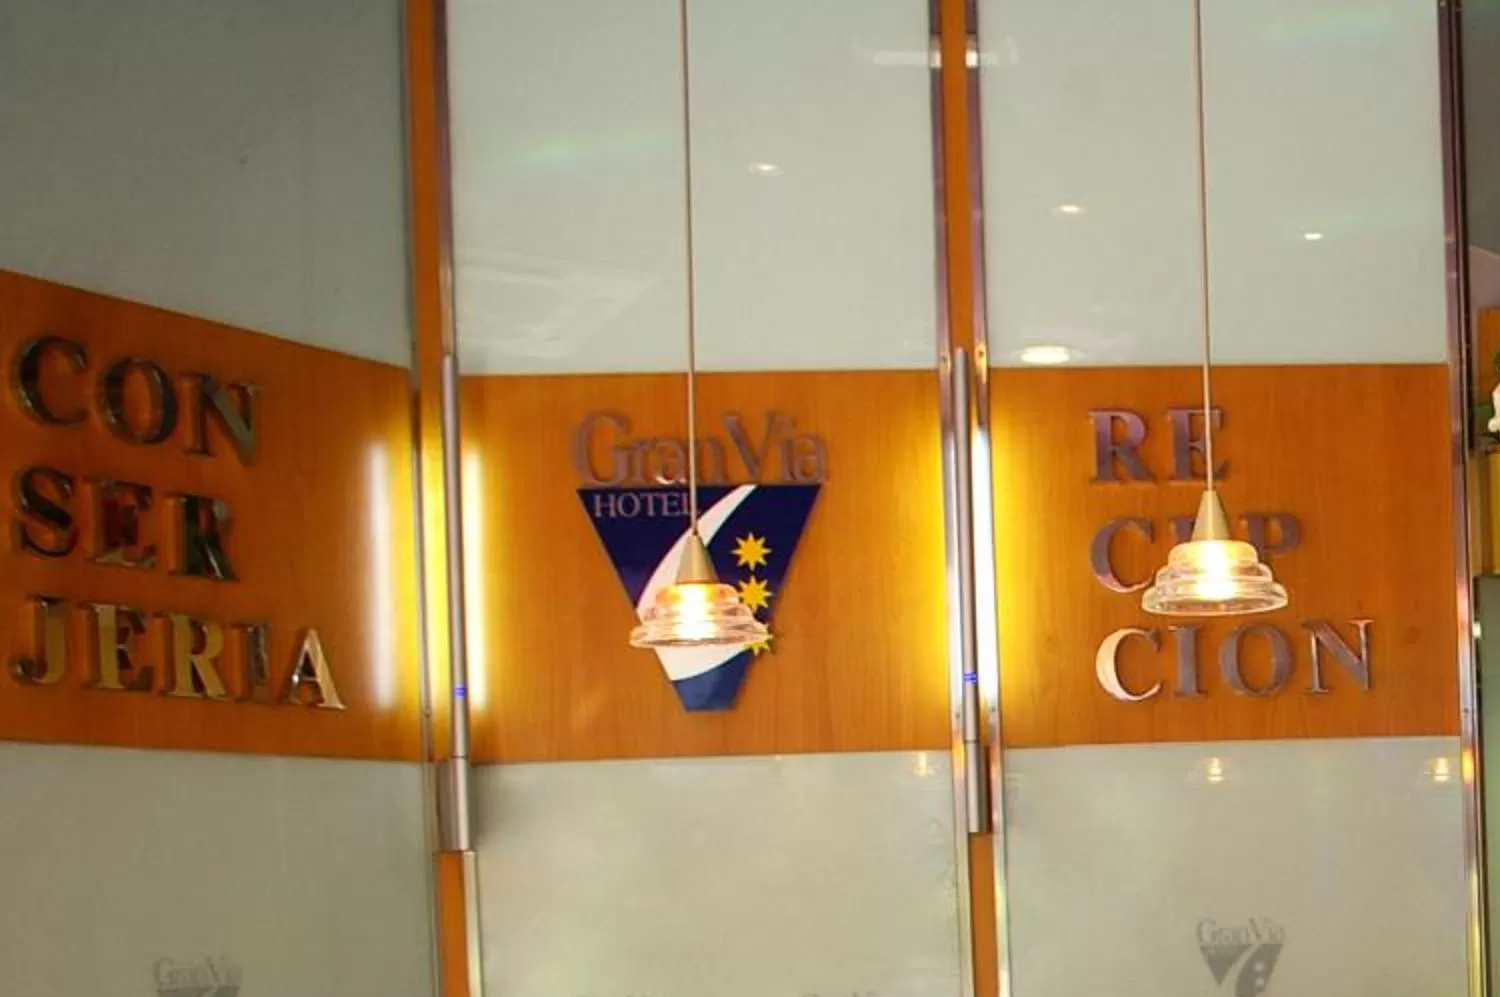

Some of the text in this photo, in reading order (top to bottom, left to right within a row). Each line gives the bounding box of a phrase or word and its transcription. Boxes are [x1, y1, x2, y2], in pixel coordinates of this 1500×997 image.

[14, 333, 262, 467] CON
[1088, 407, 1230, 487] RE
[12, 464, 240, 583] SER
[593, 491, 700, 518] HOTEL
[1088, 510, 1305, 594] CP
[10, 595, 347, 711] JERIA
[1095, 618, 1375, 702] CION
